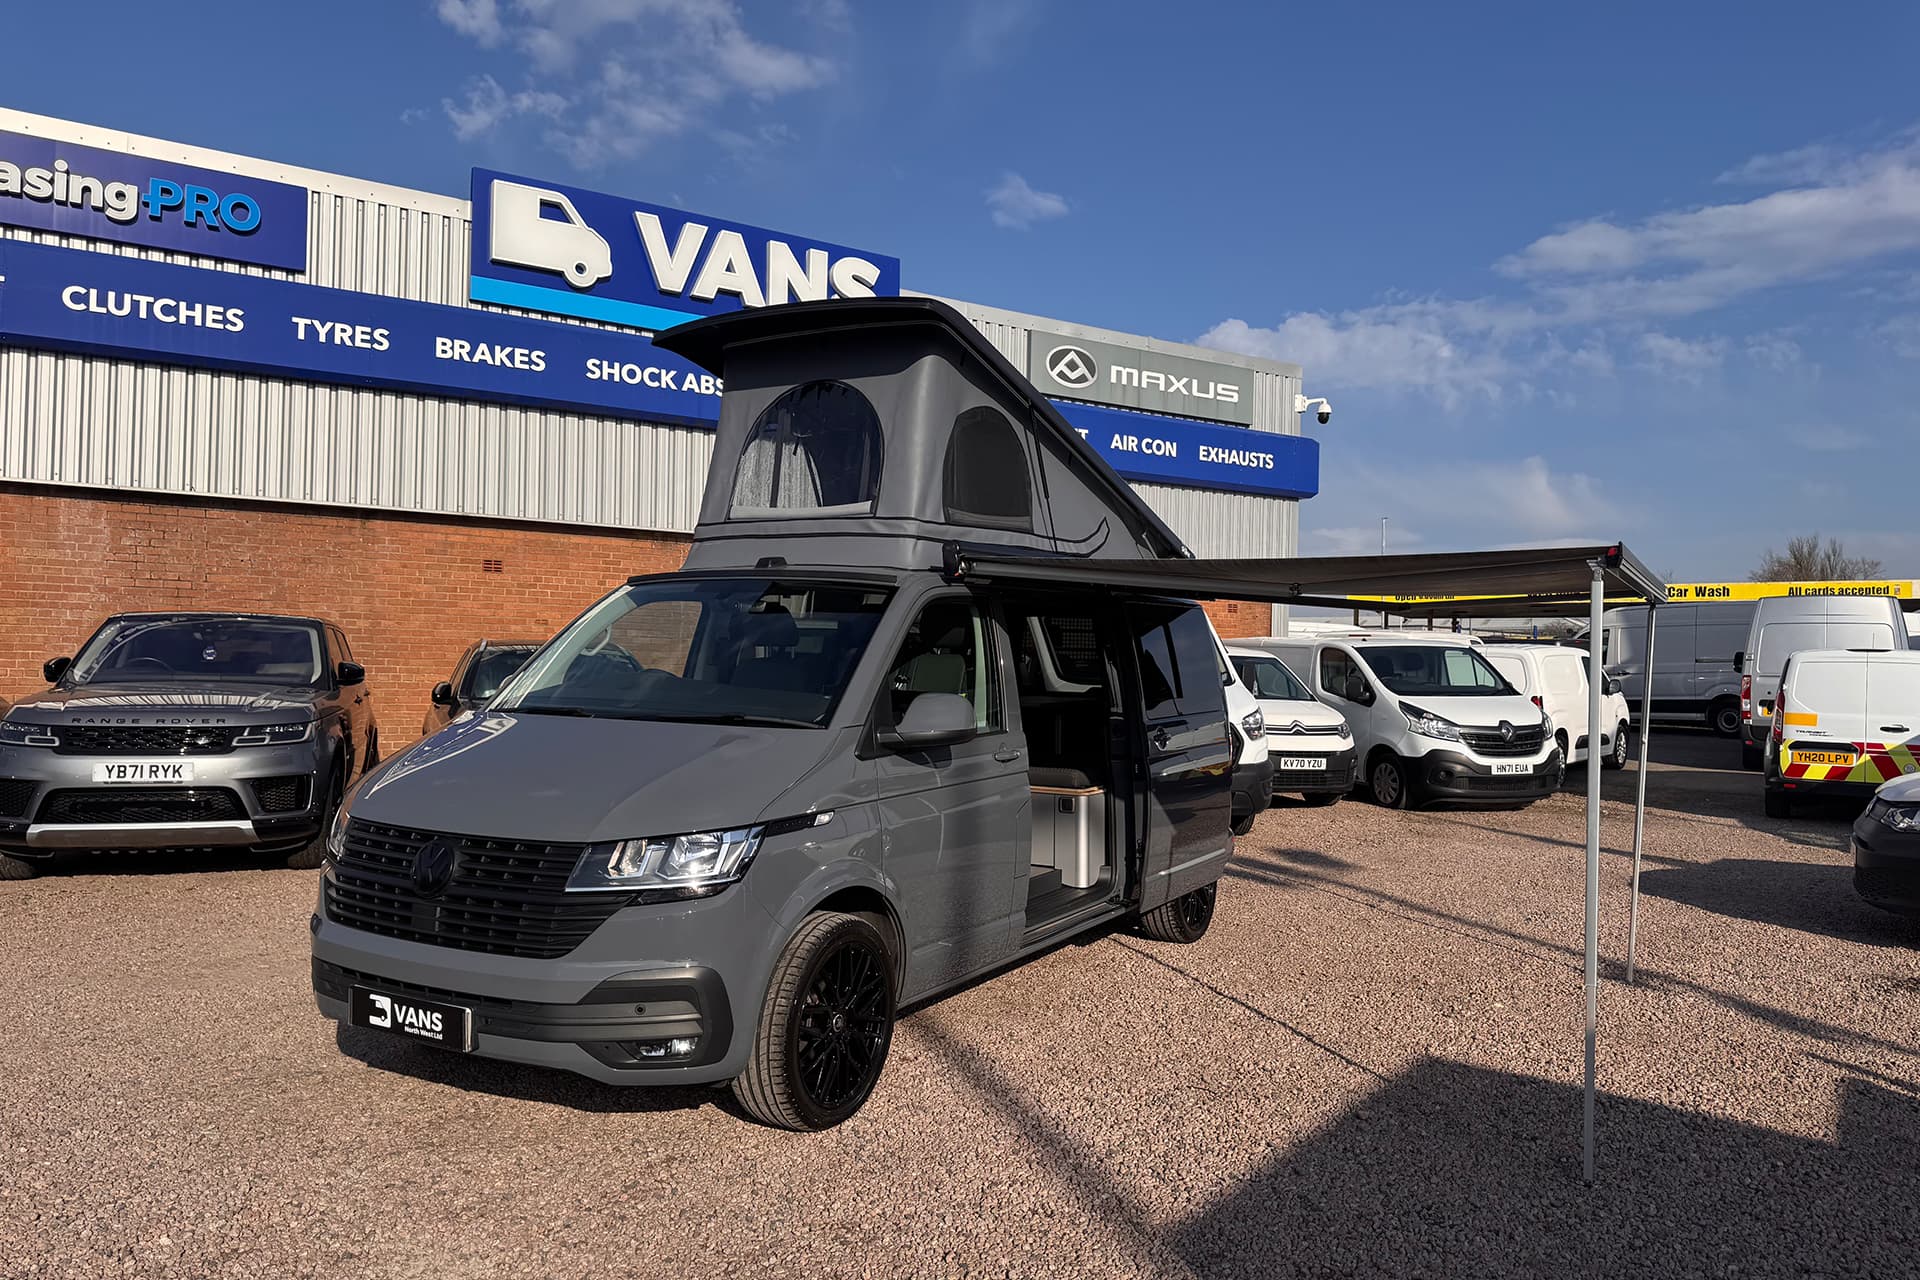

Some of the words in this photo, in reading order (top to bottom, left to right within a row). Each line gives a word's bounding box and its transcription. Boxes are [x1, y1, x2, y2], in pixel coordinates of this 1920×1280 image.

[634, 211, 881, 308] VANS
[62, 286, 245, 332] CLUTCHES
[291, 316, 391, 352] TYRES
[435, 336, 547, 372] BRAKES
[585, 358, 677, 390] SHOCK
[1110, 364, 1240, 403] MAXUS
[1110, 433, 1138, 453] AIR
[1140, 438, 1177, 457] CON
[1199, 445, 1274, 470] EXHAUSTS
[1668, 586, 1689, 598] Car
[1694, 585, 1730, 598] Wash
[1788, 586, 1802, 596] All
[1804, 586, 1836, 596] cards
[1837, 585, 1890, 596] accepted
[1283, 759, 1305, 768] KV70
[1307, 759, 1323, 769] YZU
[1496, 764, 1513, 773] HN71
[1515, 764, 1529, 772] EUA
[1797, 753, 1825, 763] YH20
[1827, 753, 1850, 764] LPV
[105, 765, 144, 779] YB71
[149, 765, 184, 779] RYK
[394, 1003, 443, 1032] VANS
[404, 1026, 420, 1035] North
[420, 1029, 434, 1038] West
